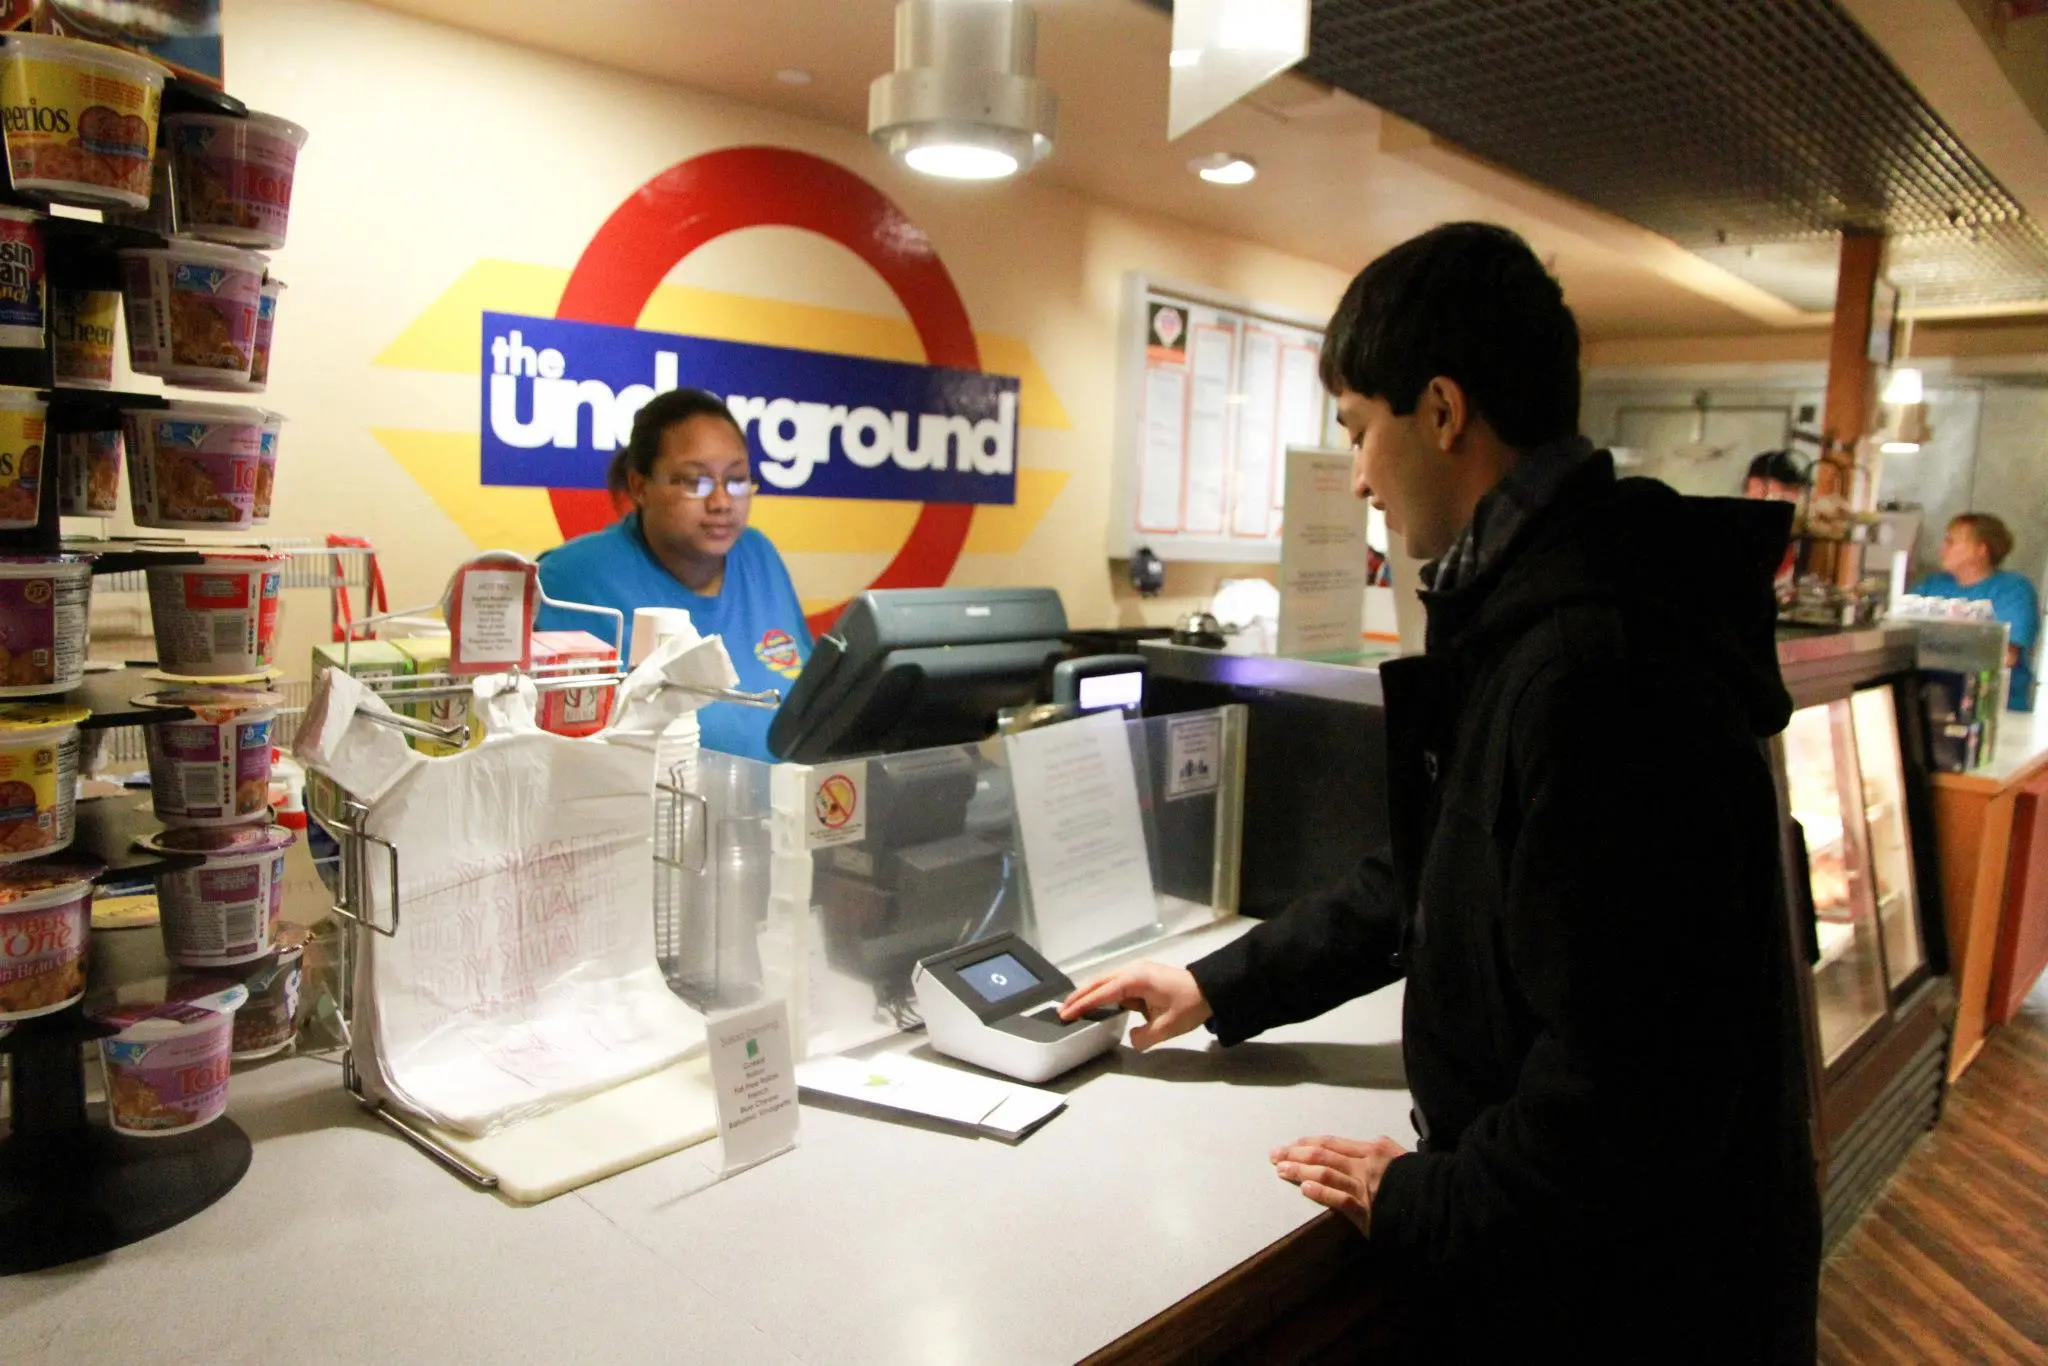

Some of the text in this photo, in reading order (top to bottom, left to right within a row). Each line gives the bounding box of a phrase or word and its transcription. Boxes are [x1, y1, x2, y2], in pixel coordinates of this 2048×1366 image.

[3, 98, 70, 133] eerios
[491, 330, 566, 379] the
[5, 927, 71, 957] One
